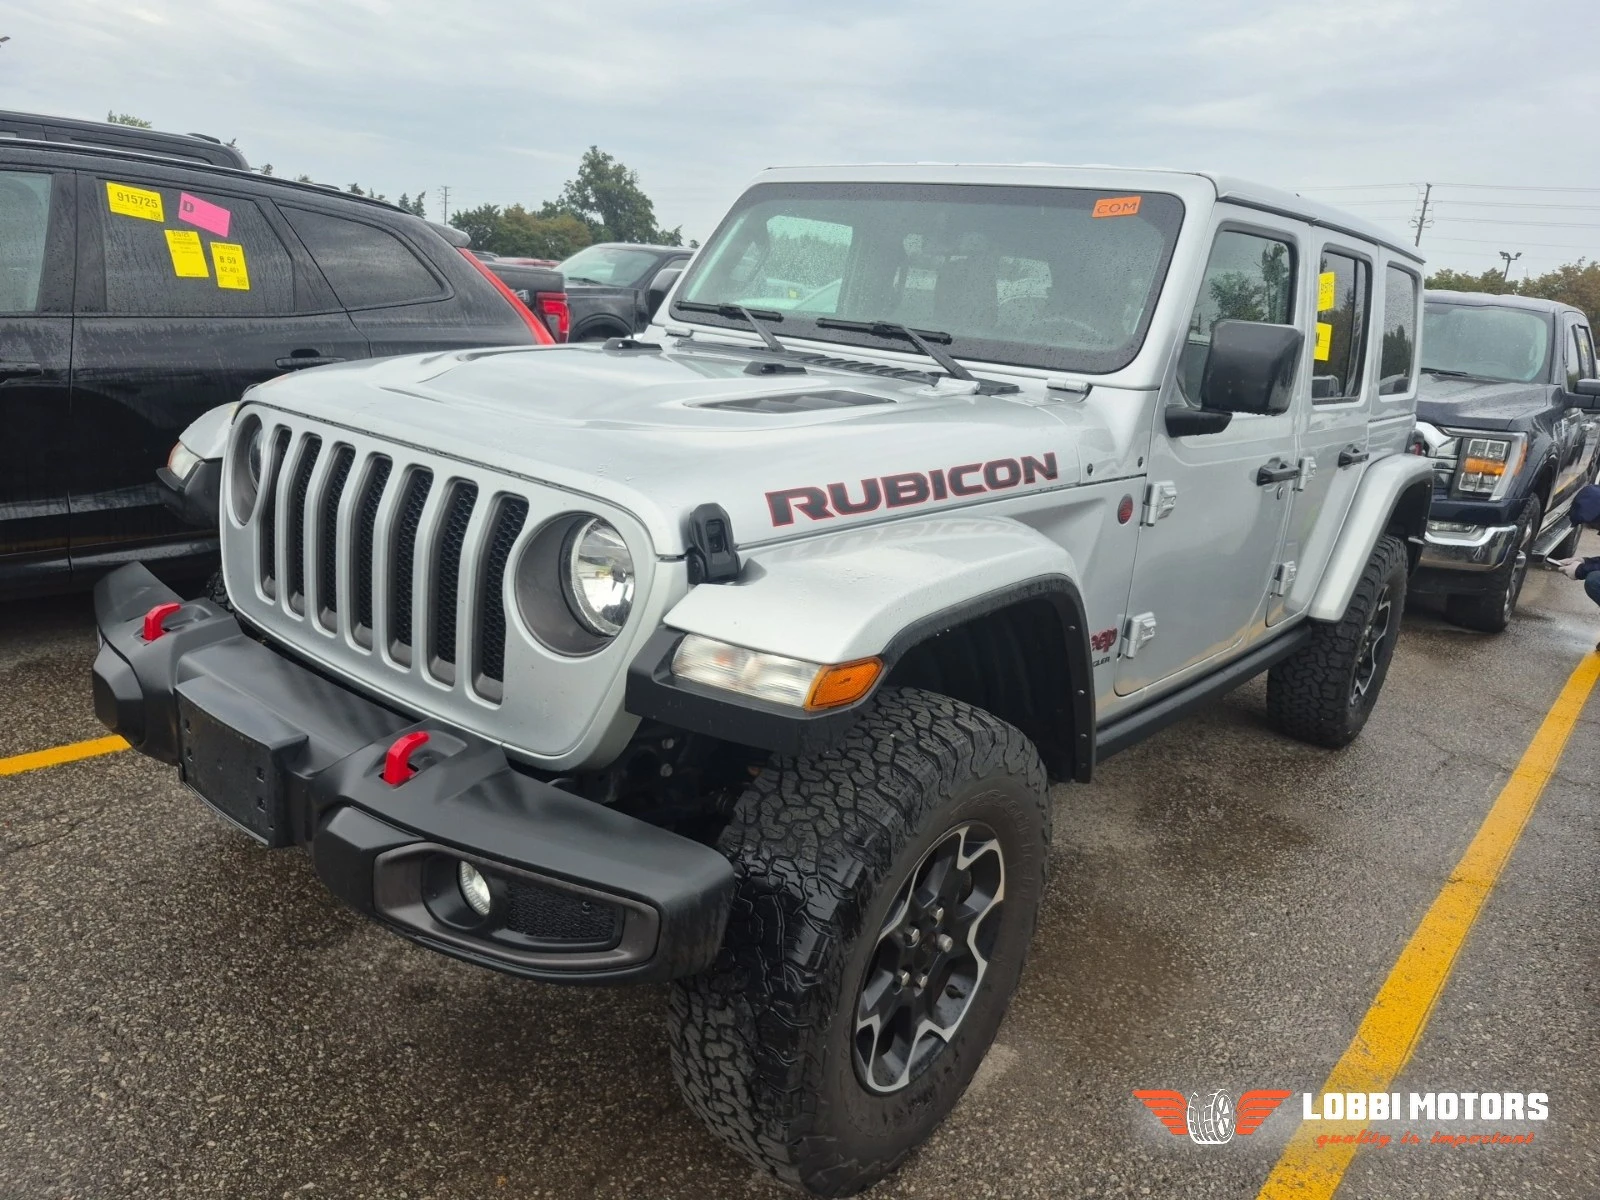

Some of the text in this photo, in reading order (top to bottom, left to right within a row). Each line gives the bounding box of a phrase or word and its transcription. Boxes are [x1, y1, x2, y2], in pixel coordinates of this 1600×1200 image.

[117, 192, 158, 208] 915725
[183, 201, 194, 213] D
[1097, 202, 1137, 214] COM
[765, 452, 1058, 527] RUBICON
[1091, 628, 1117, 653] eep
